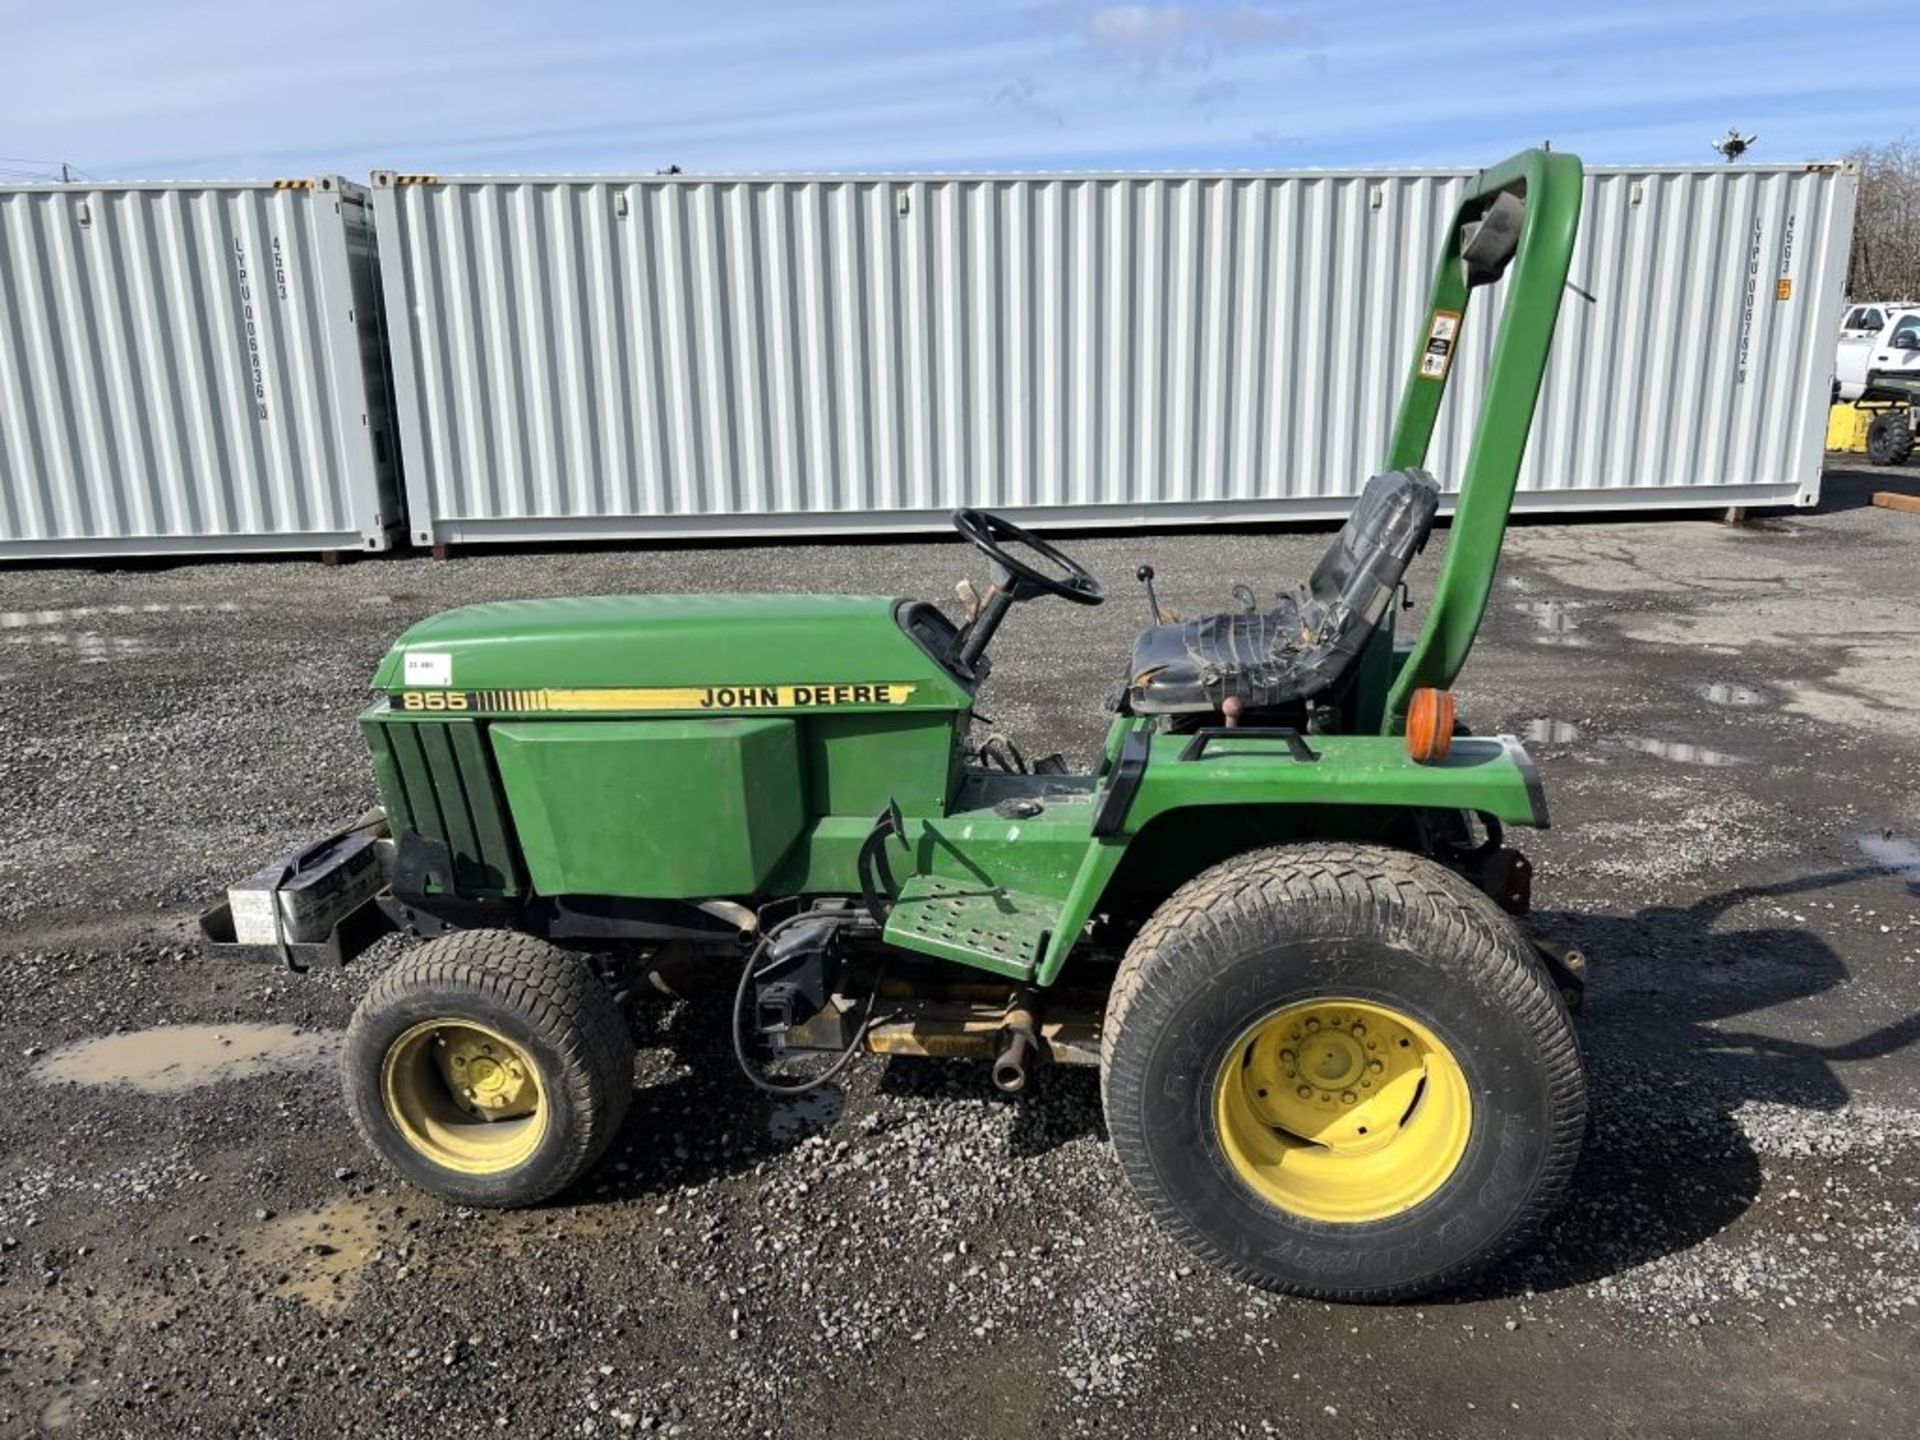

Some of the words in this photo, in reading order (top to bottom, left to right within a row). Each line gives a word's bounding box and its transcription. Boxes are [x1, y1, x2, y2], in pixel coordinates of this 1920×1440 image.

[1749, 218, 1761, 274] LYPU
[234, 238, 250, 300] LYPU
[403, 691, 469, 710] 855
[700, 687, 779, 707] JOHN
[793, 684, 891, 706] DEERE
